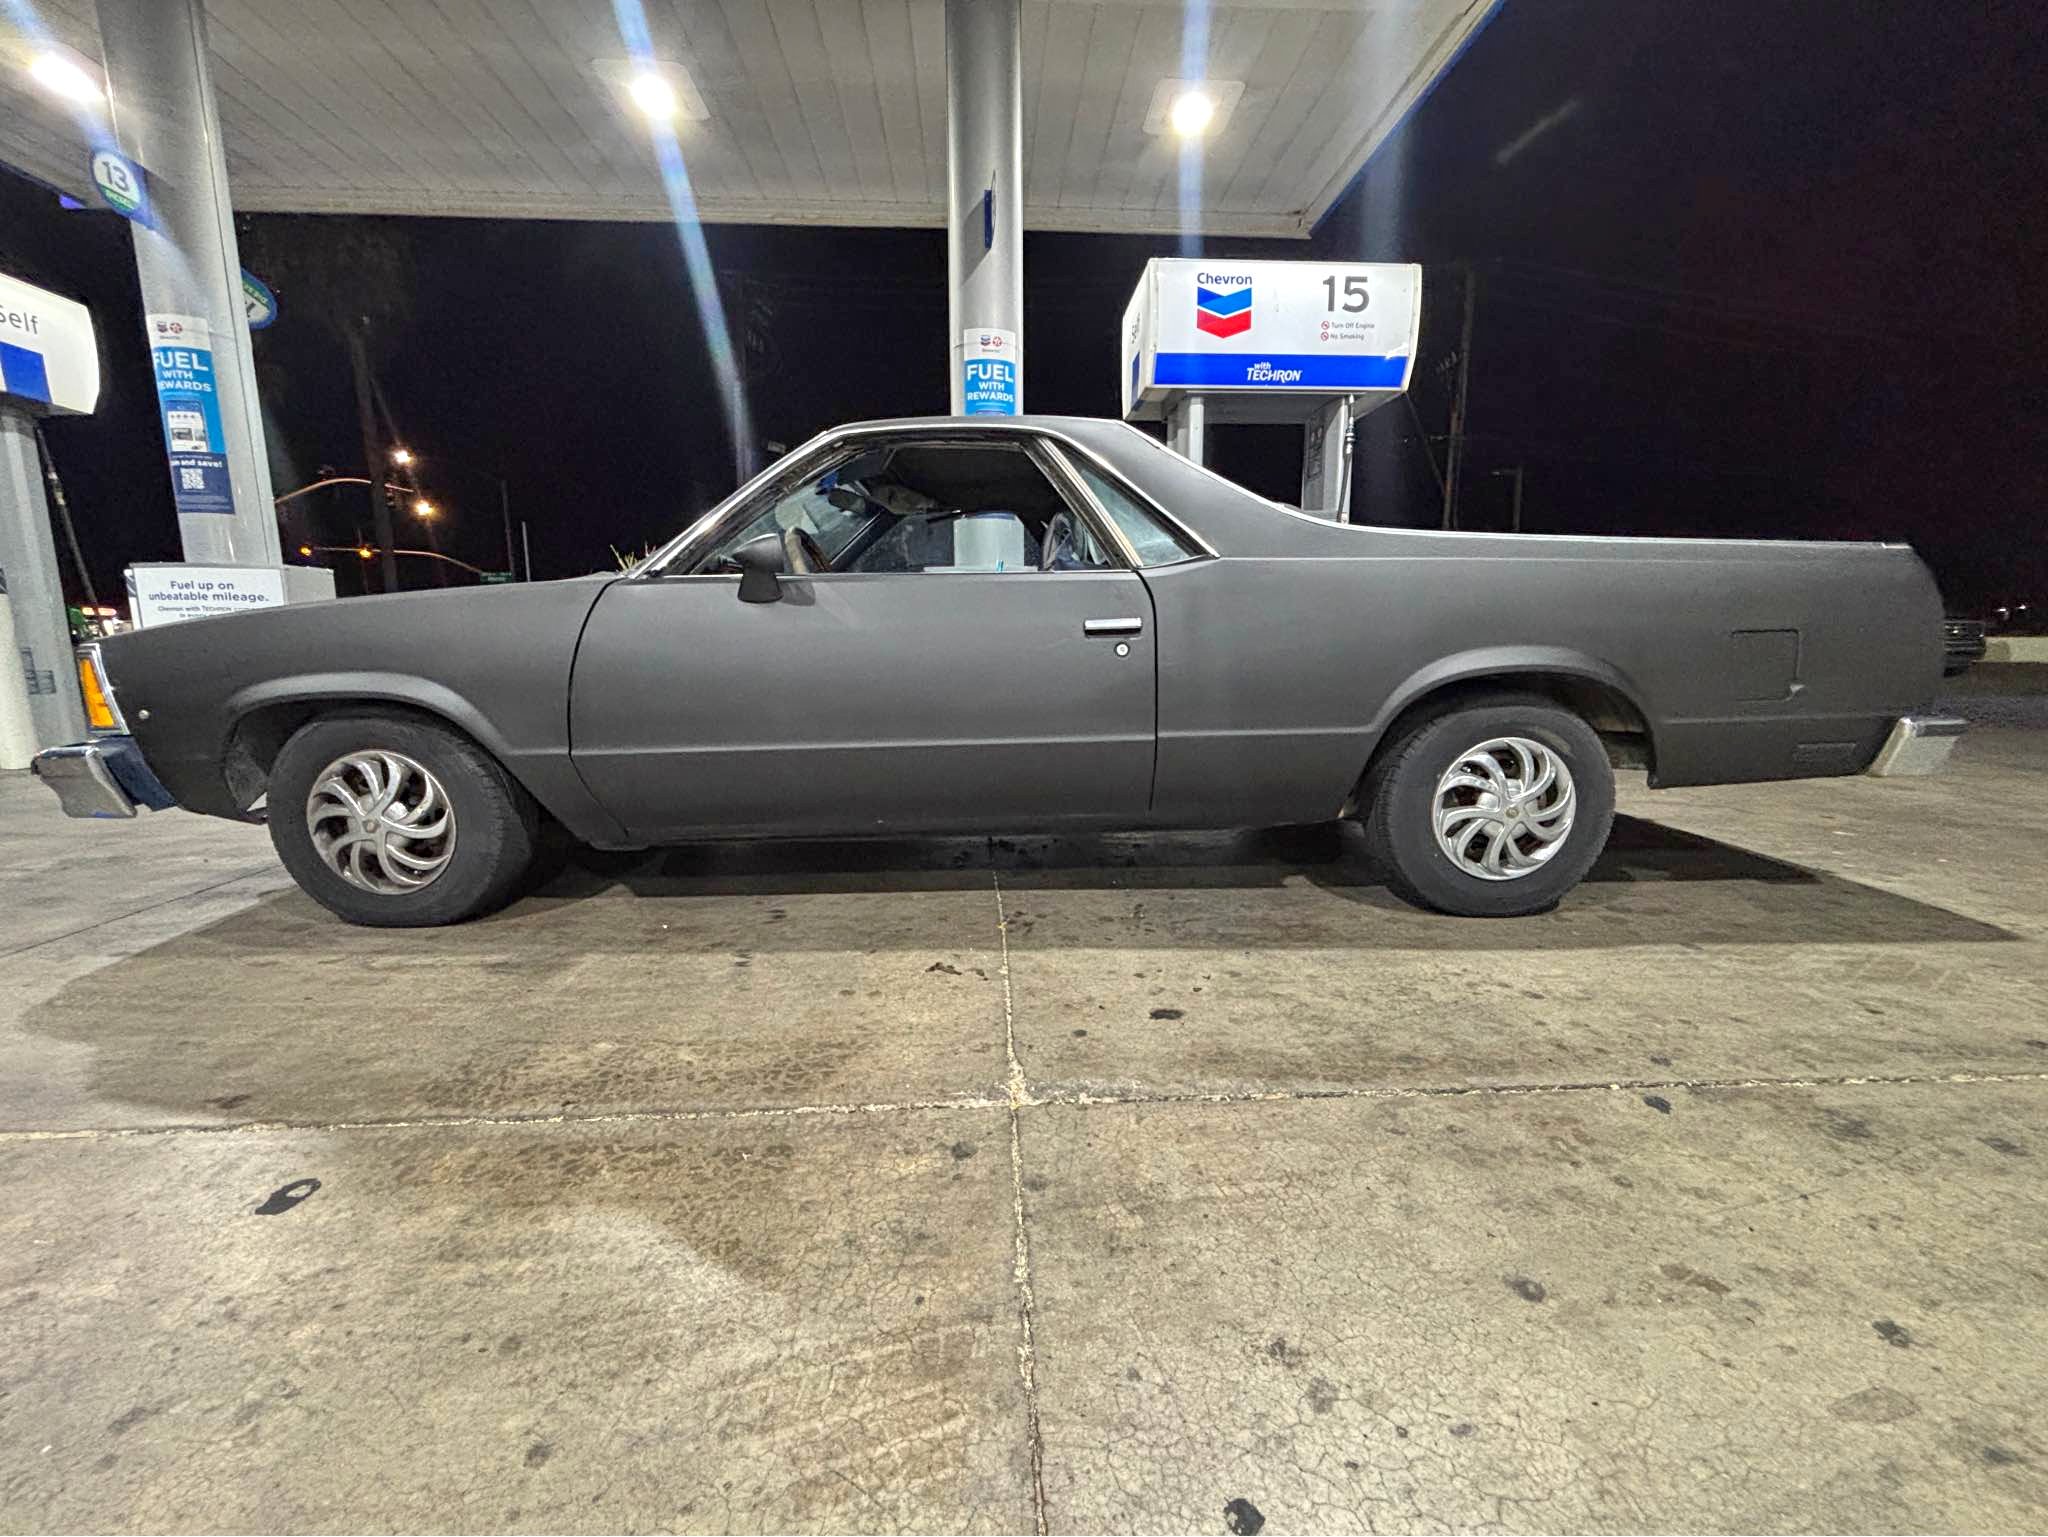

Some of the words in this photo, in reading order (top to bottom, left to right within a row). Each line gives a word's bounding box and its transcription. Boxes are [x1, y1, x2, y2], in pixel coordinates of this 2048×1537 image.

[102, 161, 129, 192] 13
[1197, 272, 1253, 285] Chevron
[1322, 275, 1370, 313] 15
[152, 351, 209, 371] FUEL
[1254, 361, 1272, 370] with
[162, 370, 193, 379] WITH
[967, 363, 1014, 383] FUEL
[1246, 367, 1303, 383] TECHRON
[158, 380, 212, 392] EWARDS
[978, 381, 1005, 391] WITH
[967, 391, 1014, 403] REWARDS
[170, 580, 194, 590] Fuel
[198, 582, 214, 592] up
[217, 582, 234, 590] on
[149, 592, 208, 601] unbeatable
[212, 592, 270, 603] mileage.
